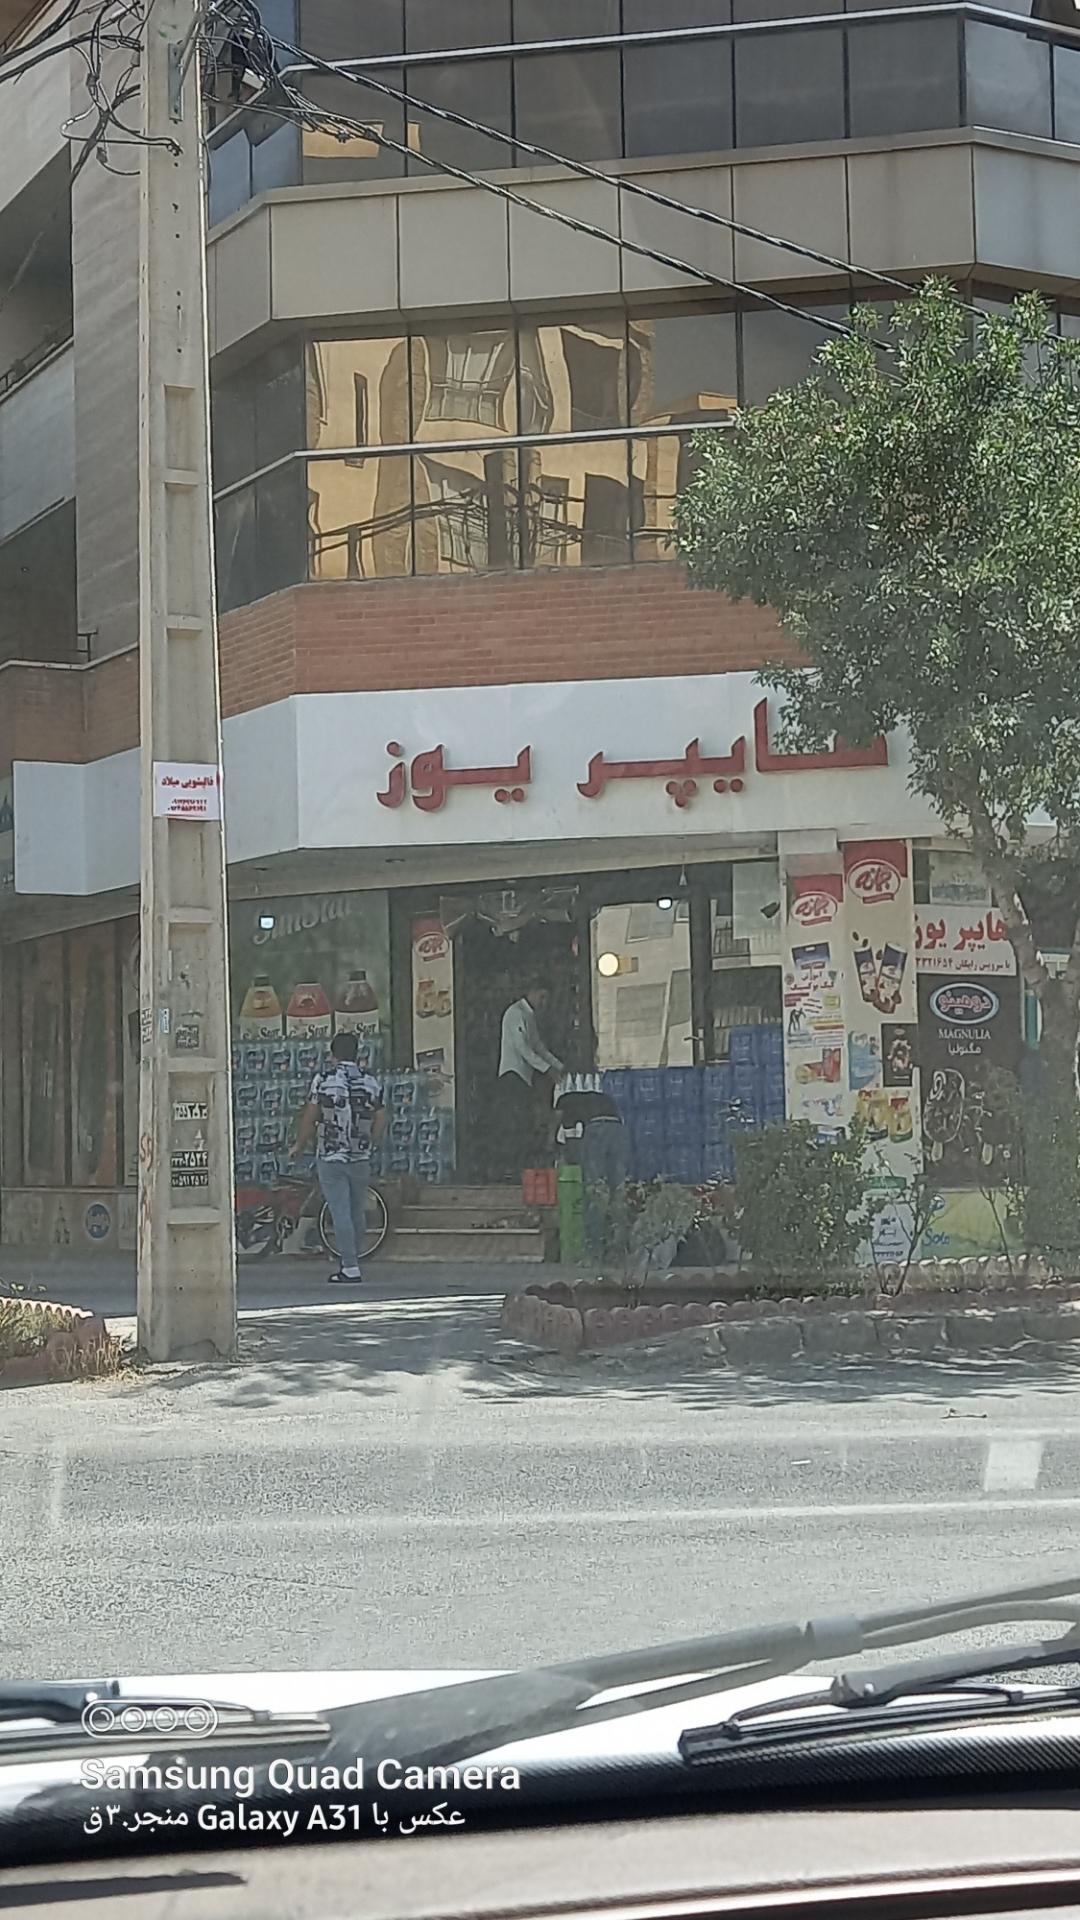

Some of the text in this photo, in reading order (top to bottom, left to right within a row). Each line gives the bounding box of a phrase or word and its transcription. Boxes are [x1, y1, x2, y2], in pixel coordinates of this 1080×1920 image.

[377, 741, 533, 812] یوز
[938, 990, 992, 1015] دومینو
[938, 1028, 991, 1040] MAGNULIA
